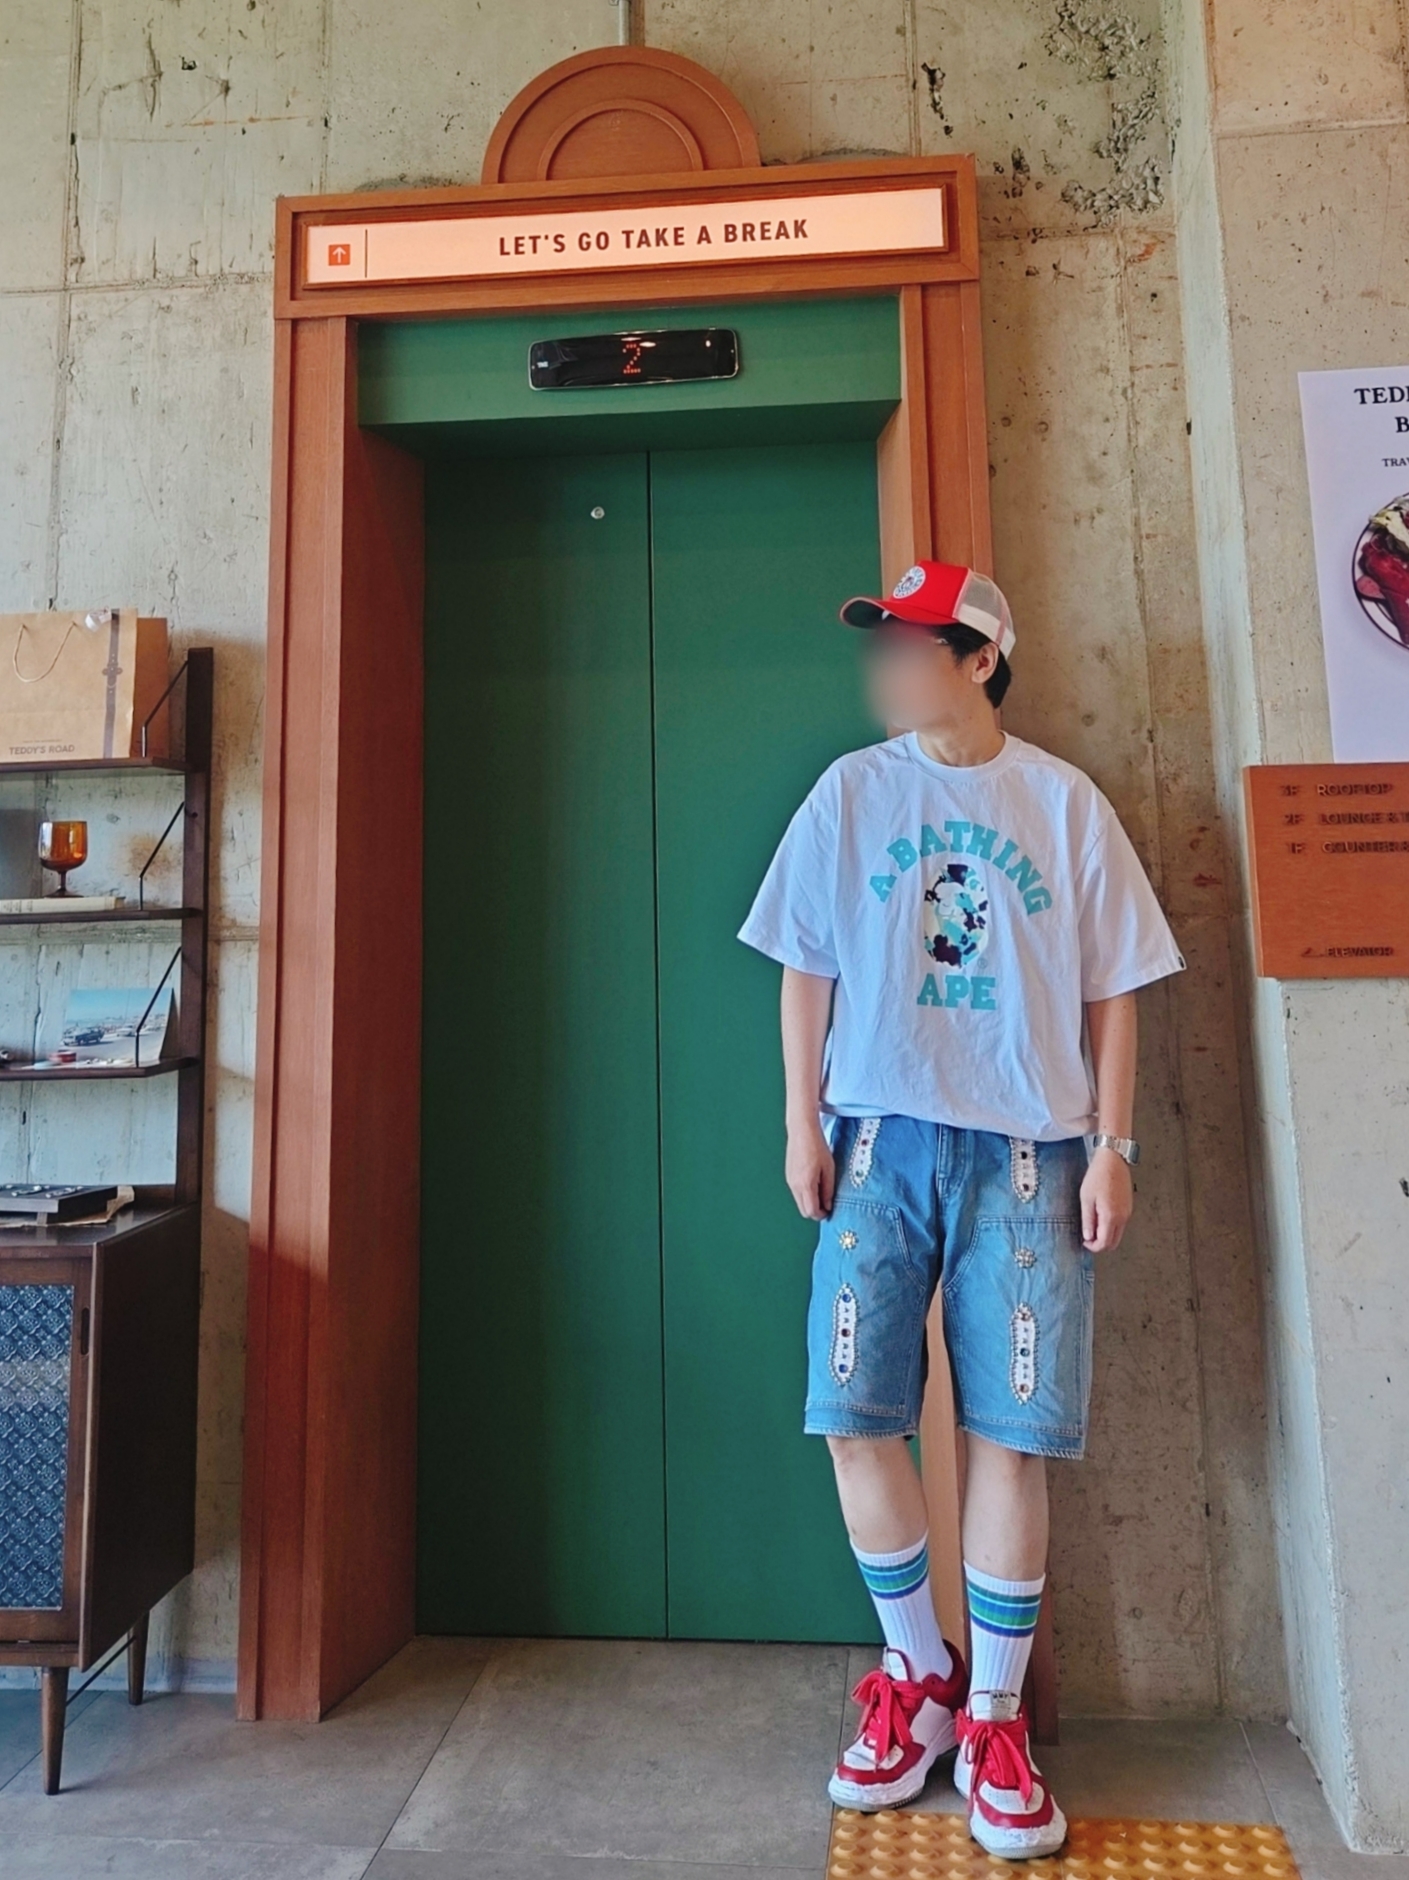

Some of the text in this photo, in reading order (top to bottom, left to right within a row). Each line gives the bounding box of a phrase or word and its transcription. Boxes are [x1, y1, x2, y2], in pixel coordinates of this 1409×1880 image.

[499, 219, 809, 256] LET'S GO TAKE A BREAK
[622, 343, 641, 374] 2
[1353, 386, 1409, 405] TED
[1381, 457, 1409, 468] TRA
[9, 744, 75, 756] TEDDY'S ROAD
[1316, 783, 1394, 797] ROOFTOP
[1319, 812, 1382, 826] LOUNGE
[869, 820, 1054, 916] A BATHING
[916, 973, 997, 1011] APE
